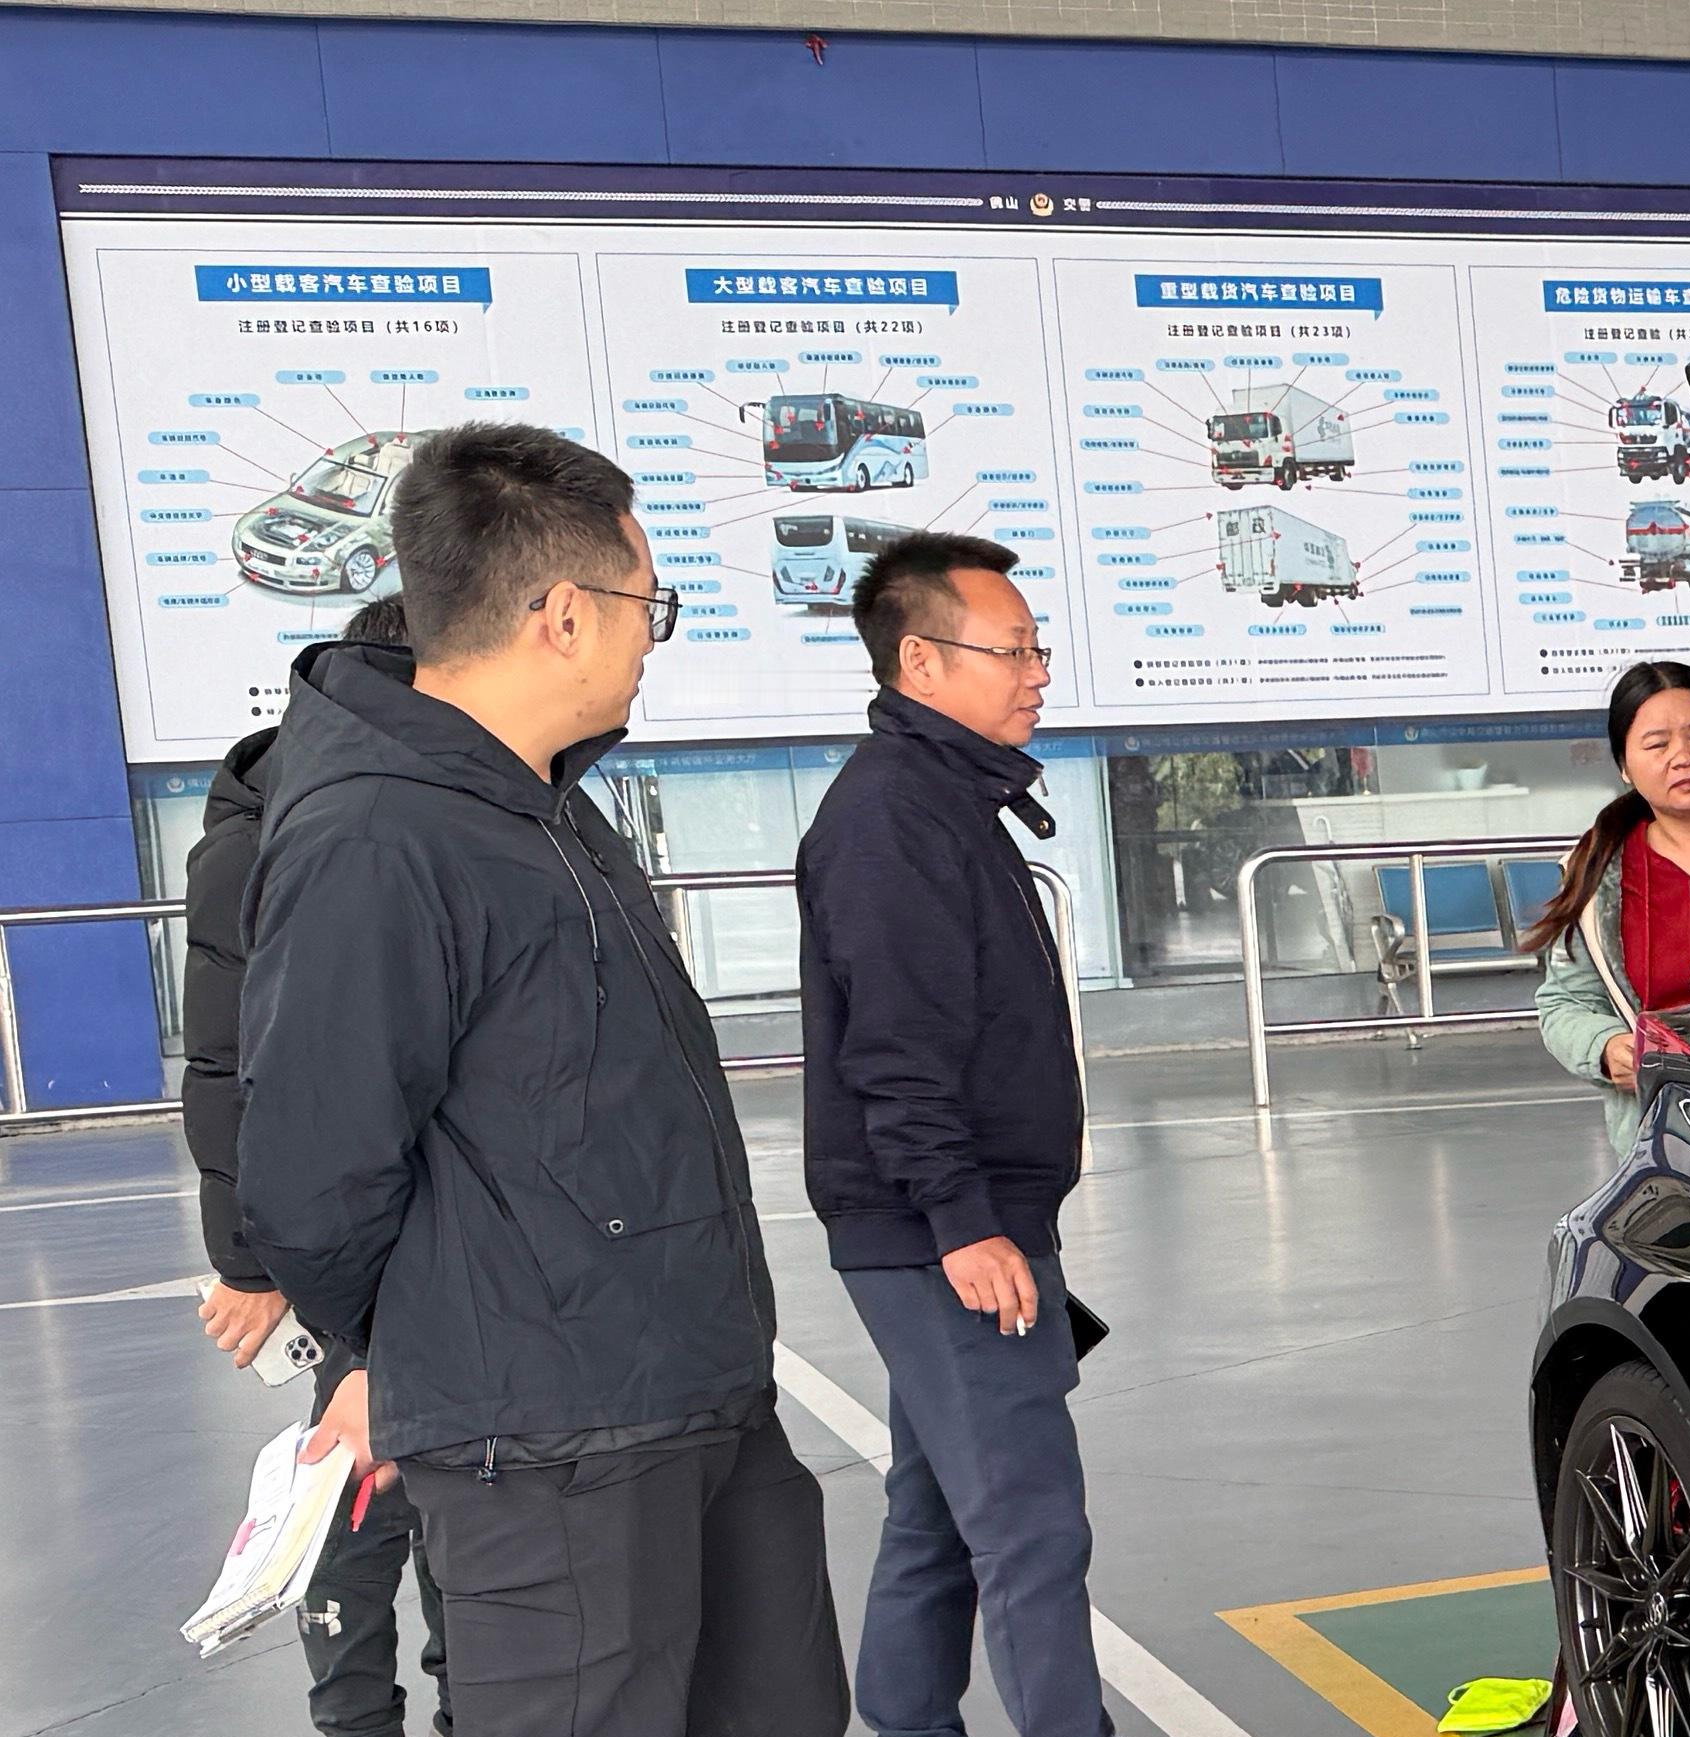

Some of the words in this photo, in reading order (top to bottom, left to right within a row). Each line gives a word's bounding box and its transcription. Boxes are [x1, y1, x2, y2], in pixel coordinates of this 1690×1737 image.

[226, 273, 462, 295] 小型载客汽车查验项目
[713, 276, 930, 297] 大型载客汽车查验项目
[1159, 280, 1357, 303] 重型载货汽车查验项目
